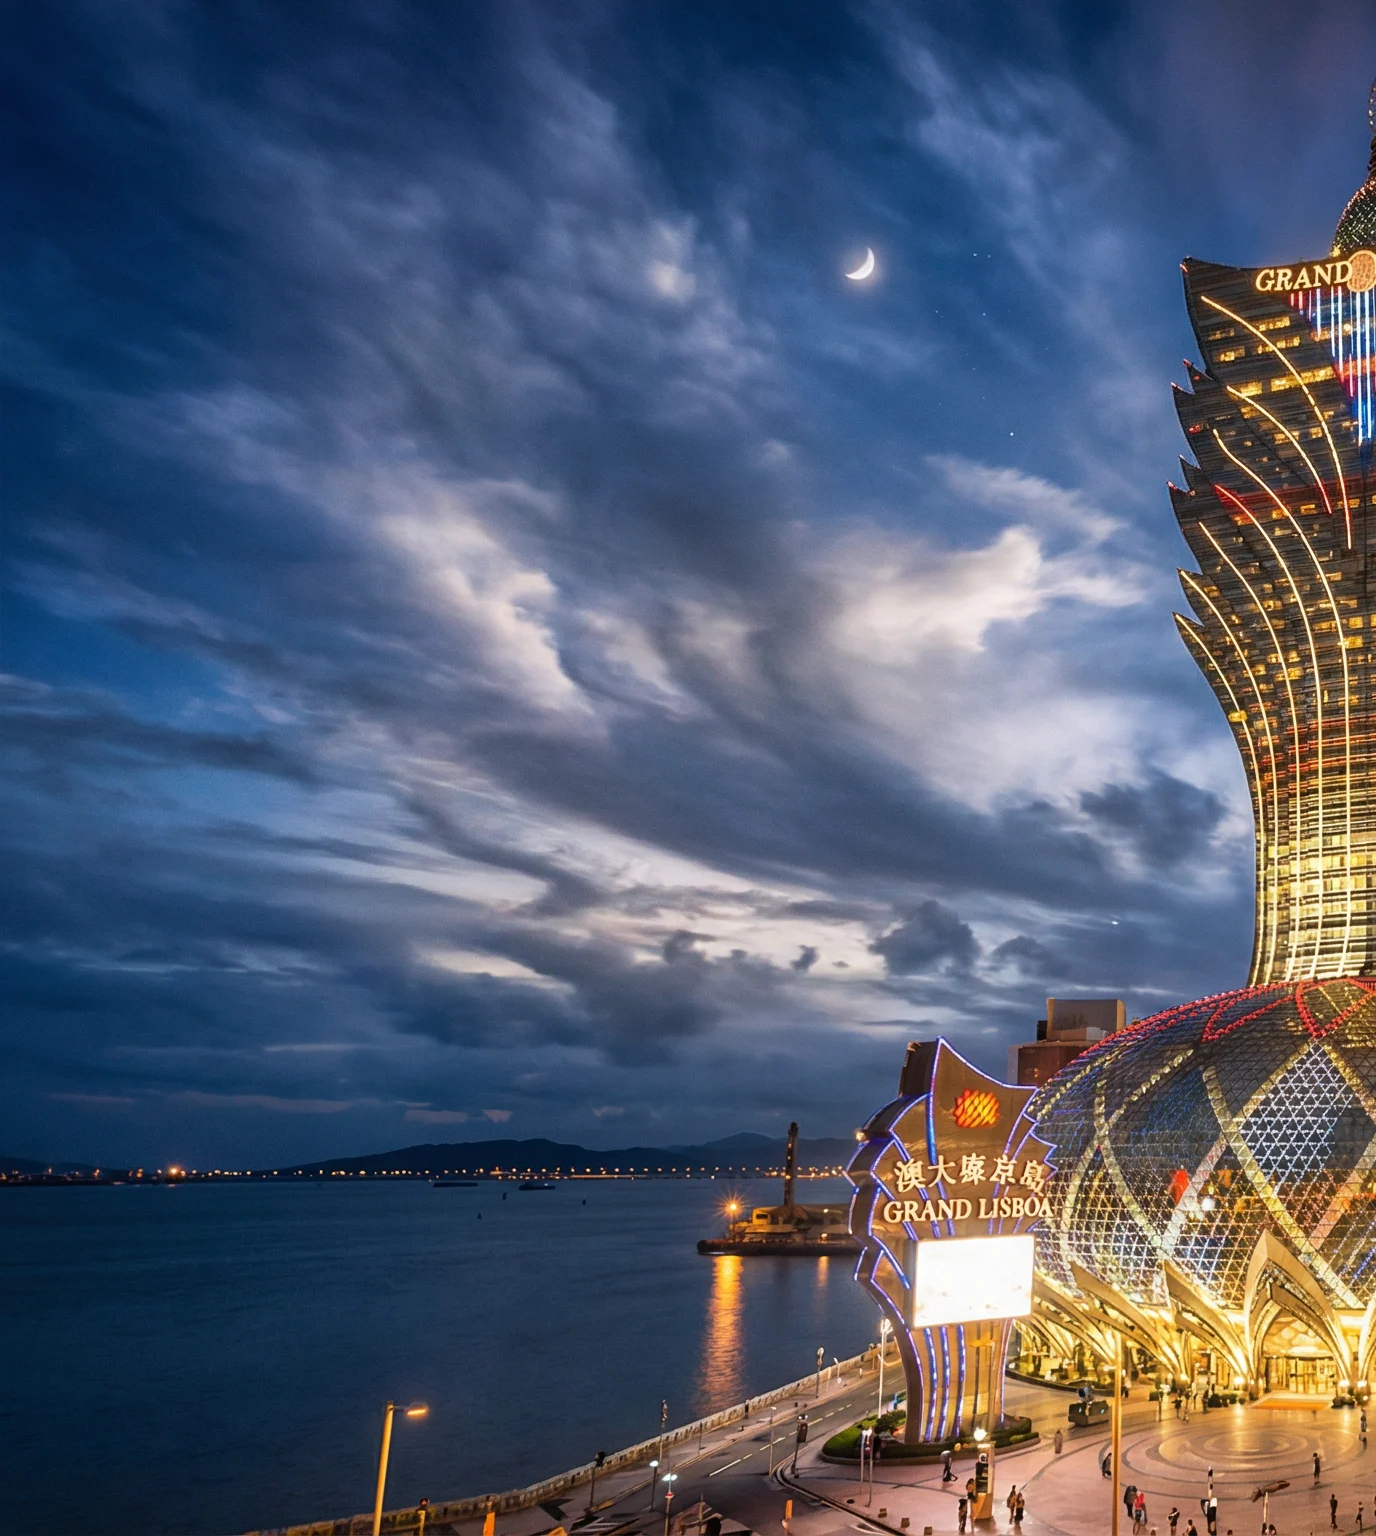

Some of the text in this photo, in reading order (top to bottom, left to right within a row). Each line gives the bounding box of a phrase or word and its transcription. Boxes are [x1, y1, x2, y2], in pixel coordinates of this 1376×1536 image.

[1255, 262, 1352, 292] GRAND
[883, 1197, 1054, 1223] GRAND LISBOA
